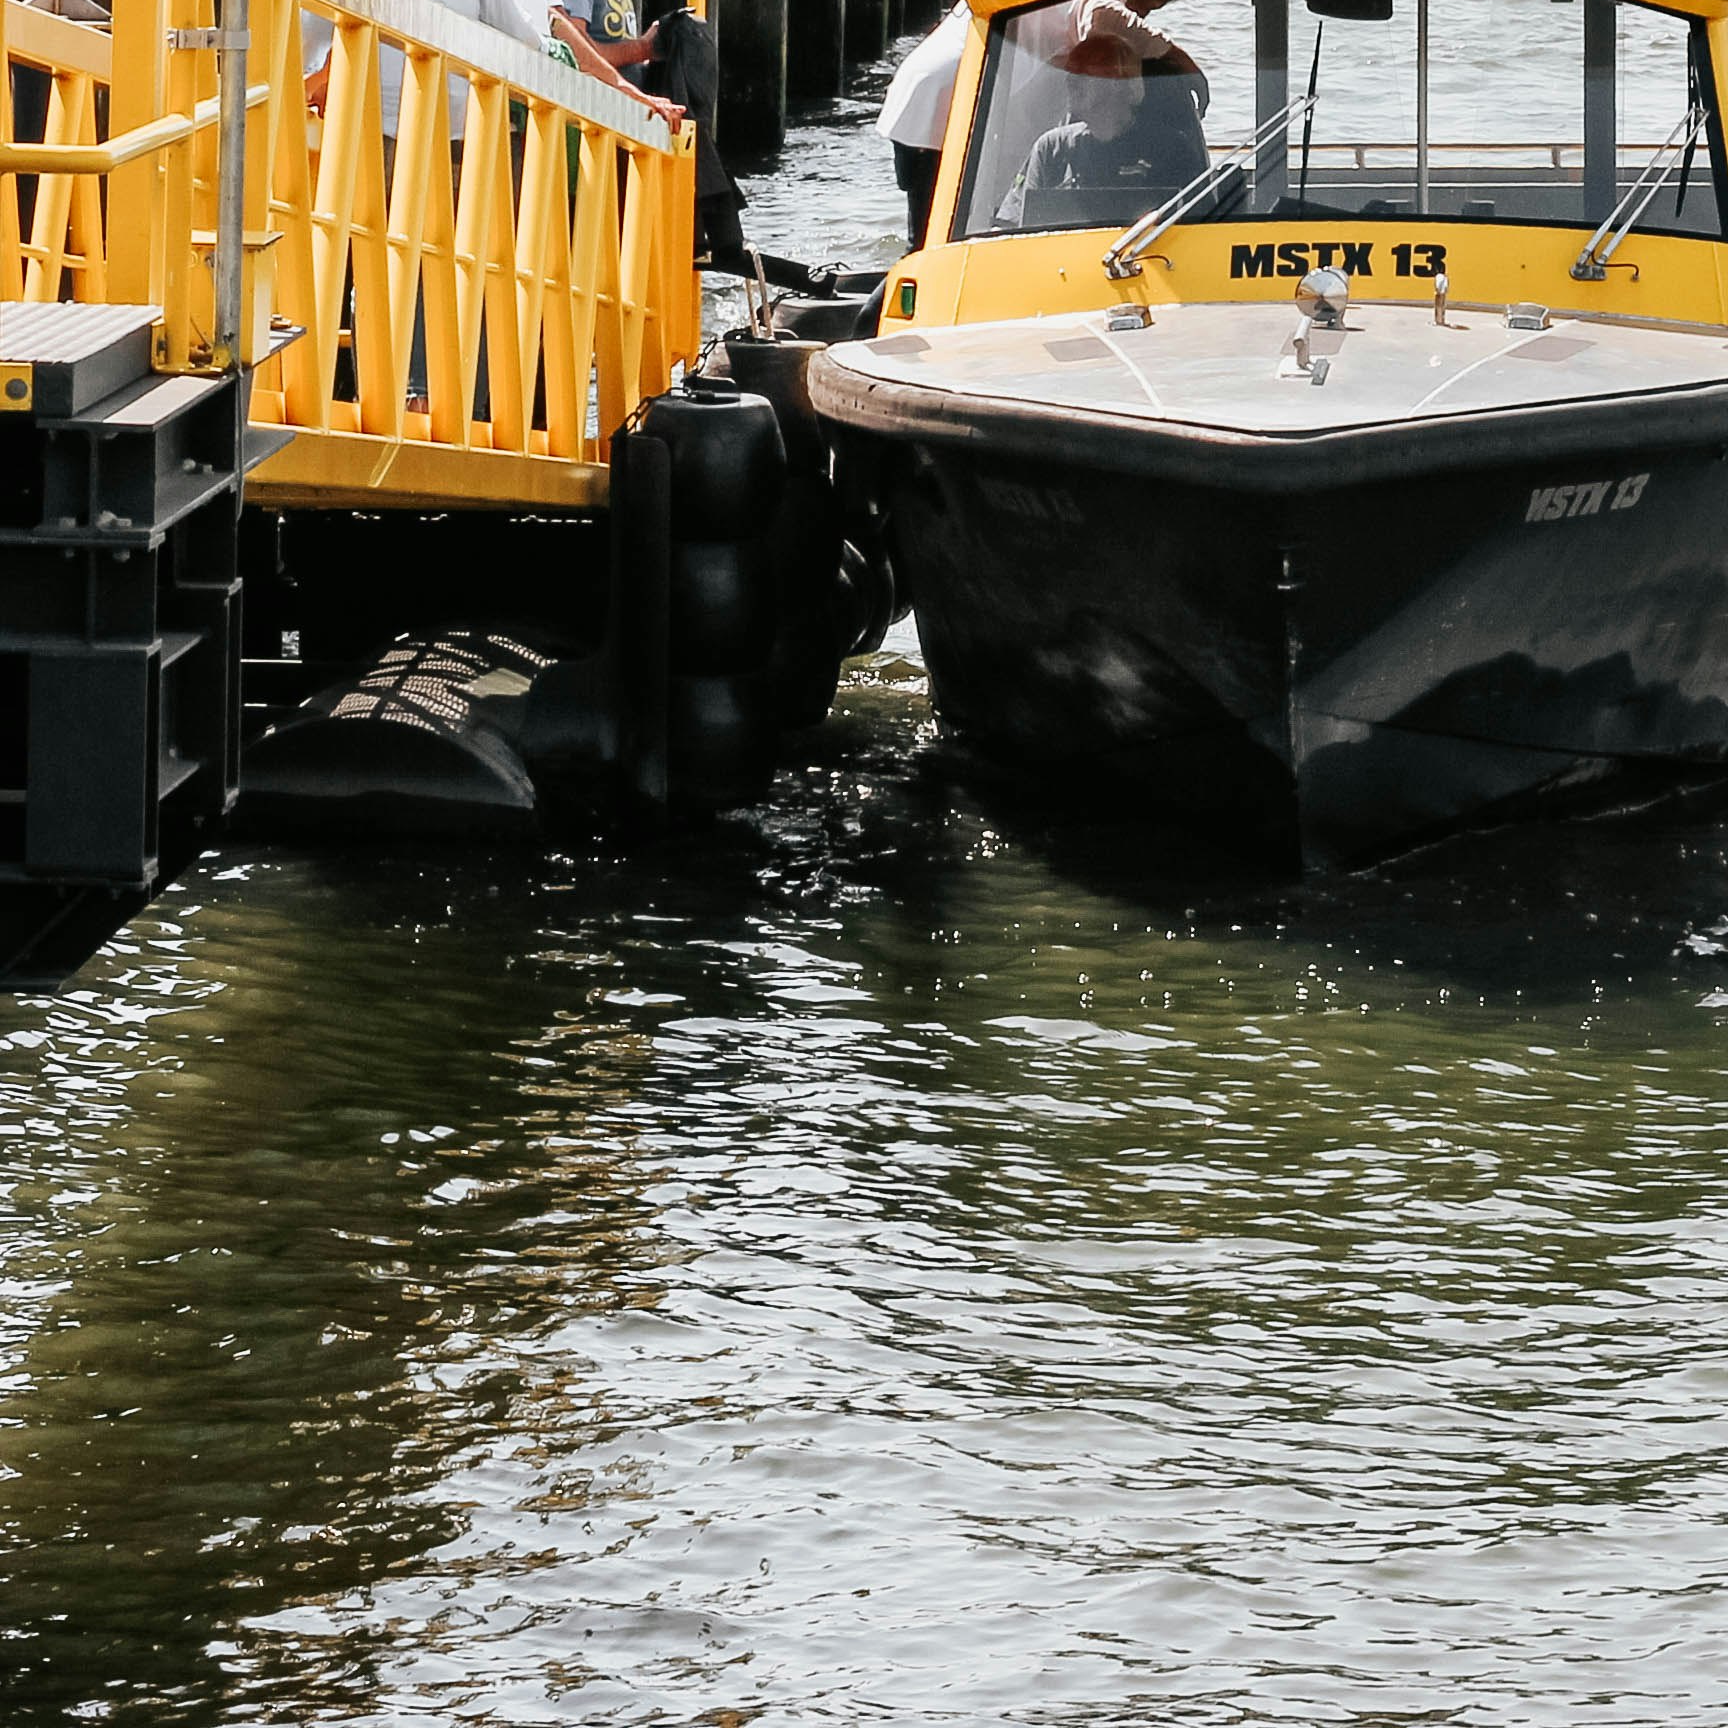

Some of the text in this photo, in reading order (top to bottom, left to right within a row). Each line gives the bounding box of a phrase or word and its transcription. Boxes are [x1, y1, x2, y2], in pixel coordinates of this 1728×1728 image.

[1229, 242, 1448, 279] MSTX 13
[1525, 481, 1614, 522] MSTX
